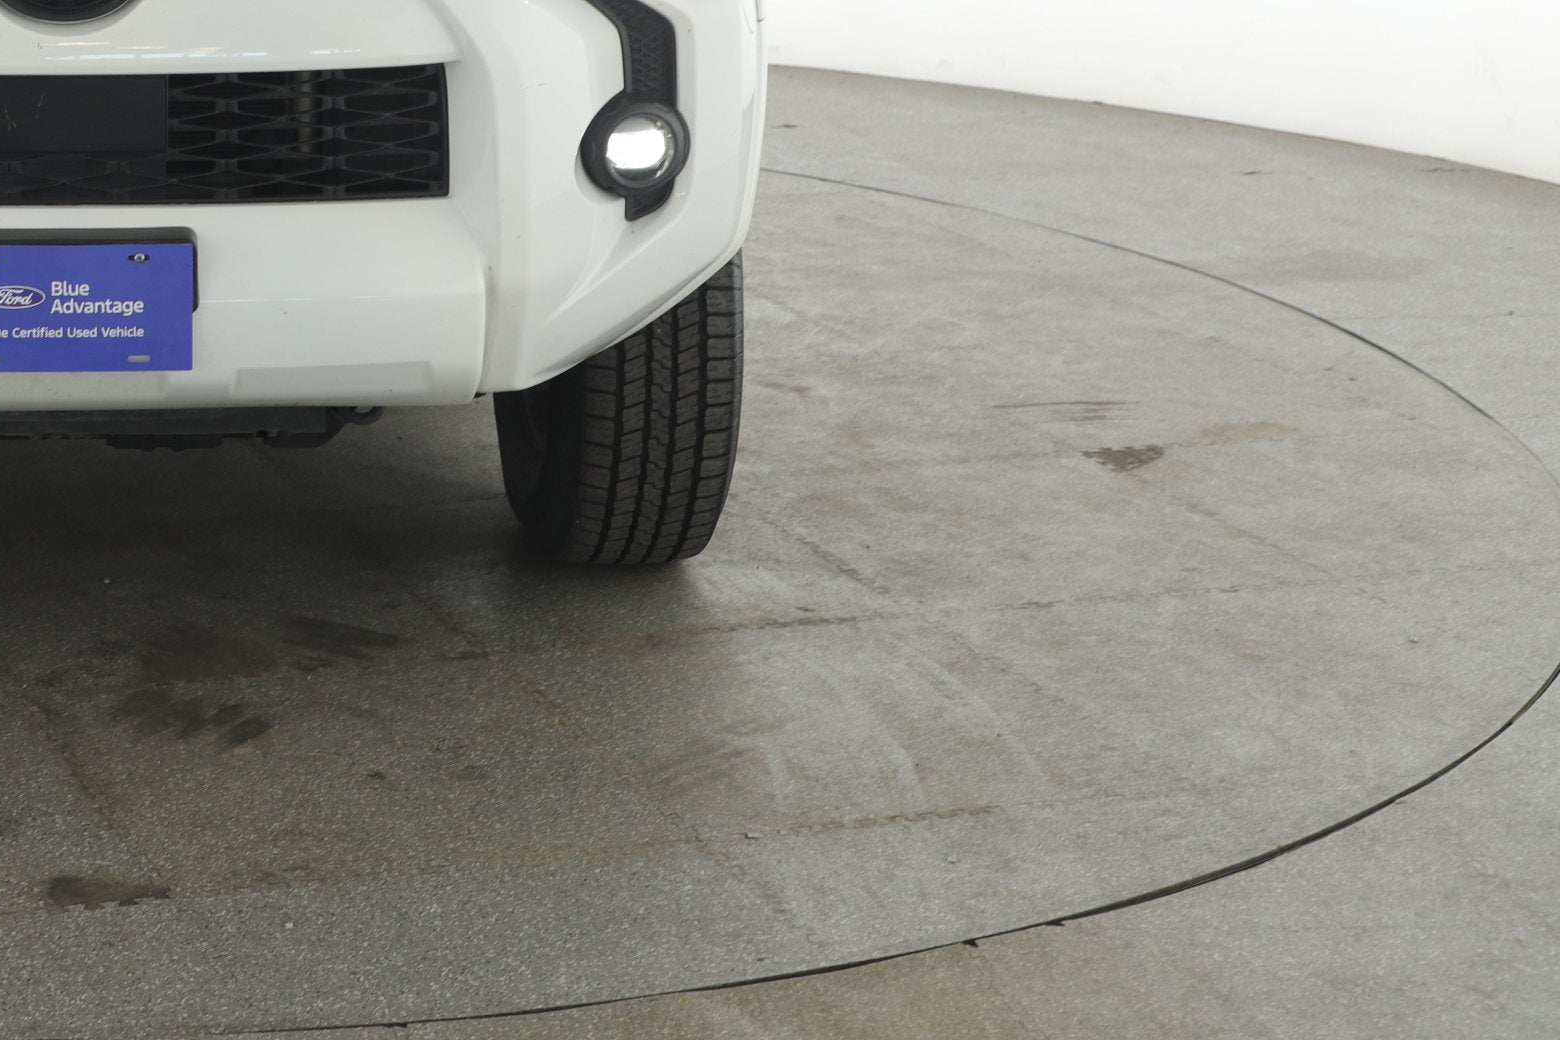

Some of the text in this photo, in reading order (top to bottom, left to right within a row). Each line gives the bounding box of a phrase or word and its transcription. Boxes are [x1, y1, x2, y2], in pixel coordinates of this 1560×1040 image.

[50, 281, 90, 297] Blue
[50, 298, 145, 317] Advantage
[11, 326, 63, 339] Certified
[66, 326, 98, 339] Used
[101, 326, 145, 338] Vehicle
